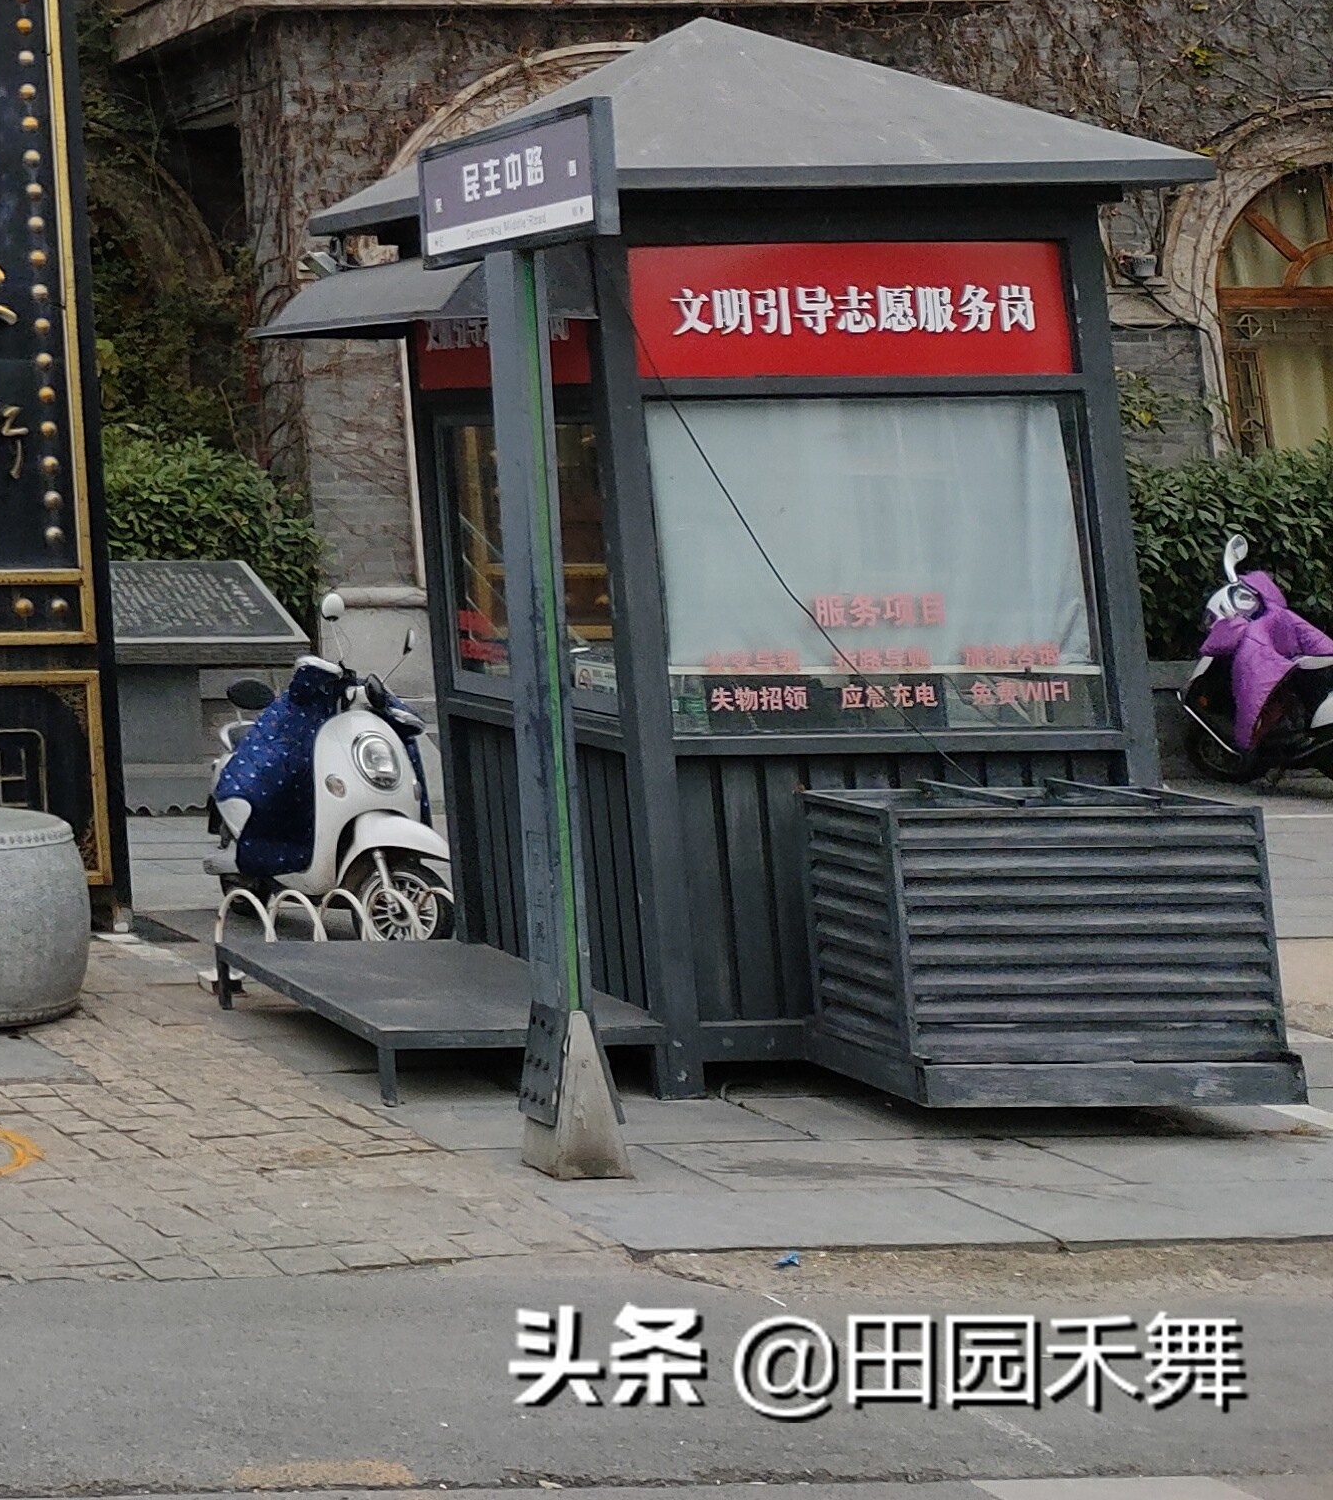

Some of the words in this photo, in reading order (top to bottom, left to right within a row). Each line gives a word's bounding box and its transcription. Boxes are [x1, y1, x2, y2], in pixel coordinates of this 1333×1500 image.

[462, 145, 545, 203] 民主中路
[670, 284, 1037, 336] 文明引导志愿服务岗
[813, 592, 947, 629] 服务项目
[710, 685, 810, 713] 失物招领
[841, 683, 939, 710] 应急充电
